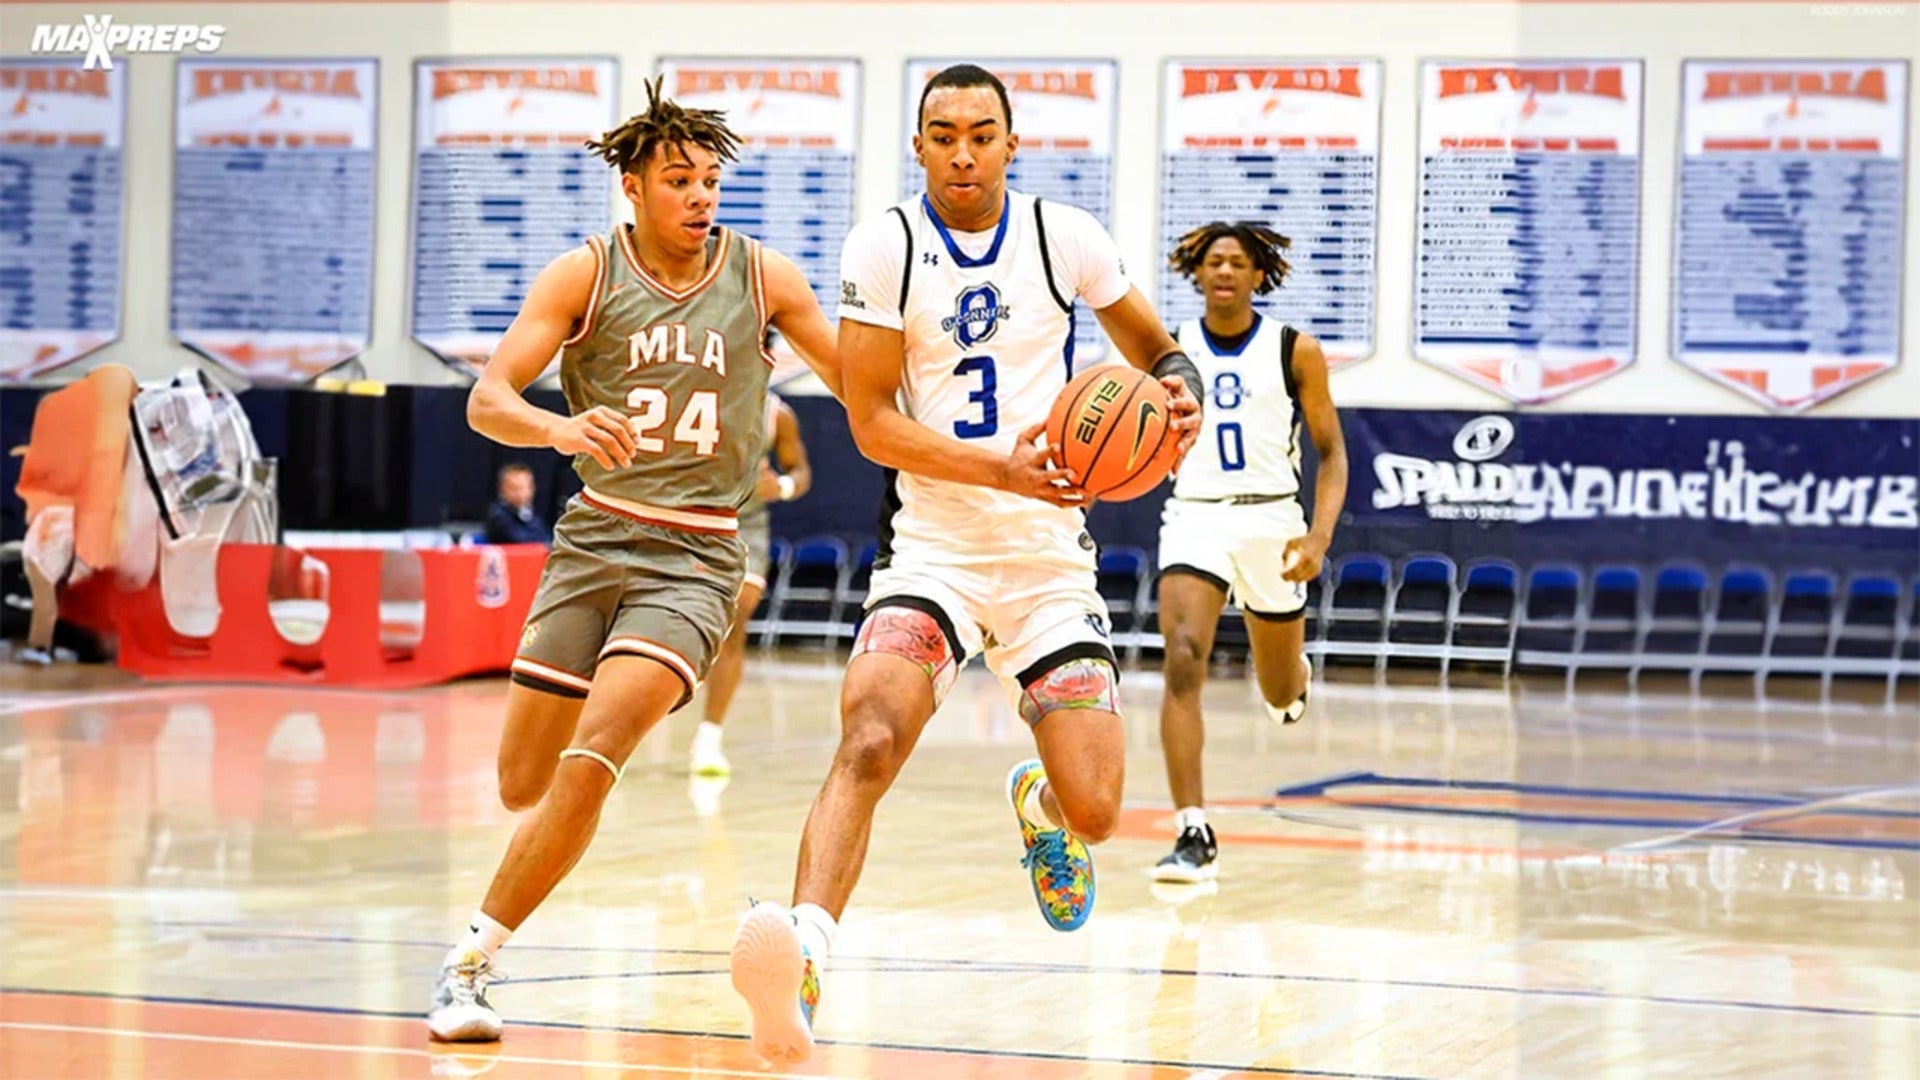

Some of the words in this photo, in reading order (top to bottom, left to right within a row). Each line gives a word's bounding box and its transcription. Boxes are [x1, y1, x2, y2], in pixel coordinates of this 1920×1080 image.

[624, 322, 727, 379] MLA
[625, 386, 721, 455] 24
[953, 356, 998, 439] 3
[1075, 380, 1124, 445] ELITE
[1217, 422, 1246, 472] 0
